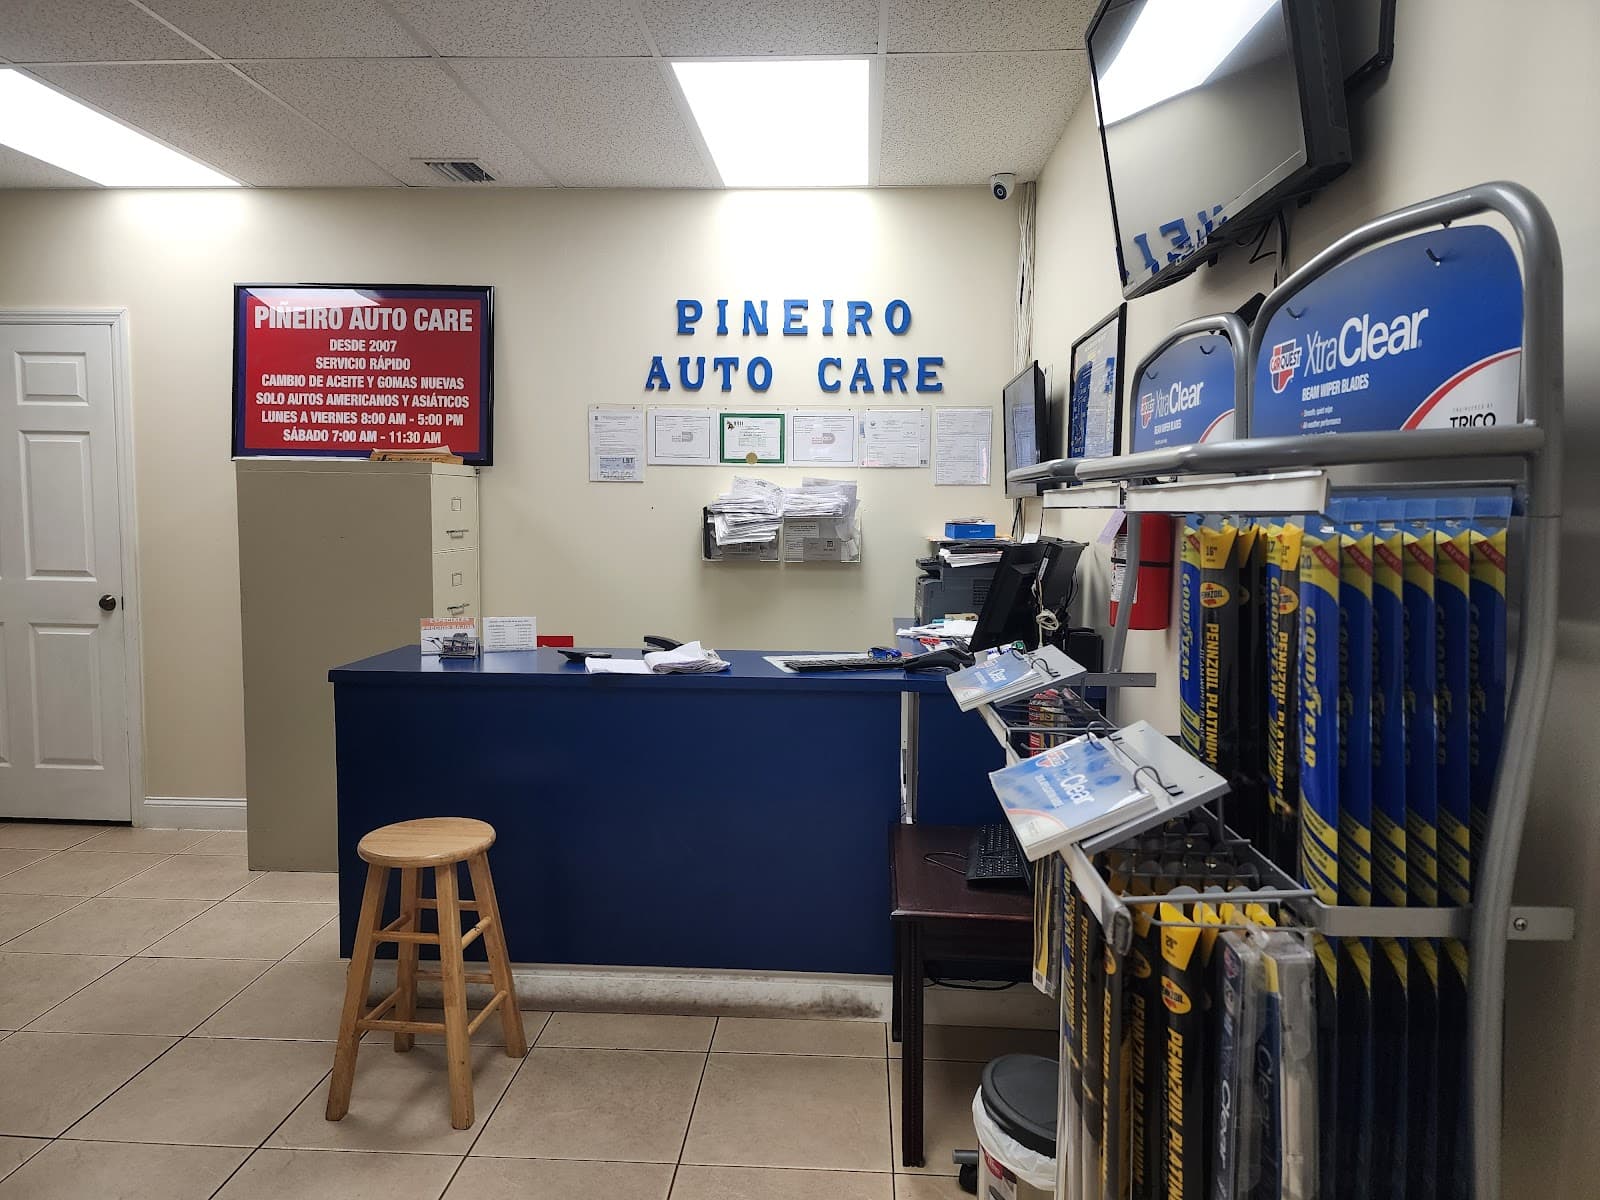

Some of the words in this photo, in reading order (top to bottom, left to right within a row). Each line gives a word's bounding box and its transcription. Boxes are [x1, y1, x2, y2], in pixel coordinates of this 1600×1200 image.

[349, 308, 407, 331] AUTO
[413, 308, 473, 332] CARE
[676, 299, 913, 336] PINEIRO
[329, 339, 366, 351] DESDE
[369, 340, 397, 352] 2007
[315, 357, 366, 370] SERVICIO
[369, 355, 411, 371] RÁPIDO
[645, 355, 773, 393] AUTO
[817, 355, 945, 393] CARE
[261, 374, 305, 387] CAMBIO
[308, 374, 324, 387] DE
[326, 375, 364, 388] ACEITE
[366, 376, 374, 388] Y
[377, 376, 417, 389] GOMAS
[420, 377, 465, 390] NUEVAS
[1302, 386, 1320, 401] BEAM
[1320, 380, 1341, 398] WIPER
[1341, 373, 1369, 395] BLADES
[255, 392, 285, 405] SOLO
[287, 393, 324, 406] AUTOS
[325, 393, 399, 407] AMERICANOS
[401, 394, 410, 407] Y
[411, 392, 470, 408] ASIÁTICOS
[261, 410, 298, 423] LUNES
[300, 411, 308, 423] A
[310, 411, 358, 424] VIERNES
[360, 412, 386, 425] 8:00
[387, 413, 406, 425] AM
[417, 413, 443, 426] 5:00
[446, 414, 464, 426] PM
[283, 426, 329, 442] SÁBADO
[331, 429, 356, 442] 7:00
[359, 430, 377, 443] AM
[388, 431, 420, 443] 11:30
[422, 431, 441, 444] AM
[1181, 573, 1194, 681] GOODYEAR
[1206, 622, 1220, 690] PENNZOIL
[1303, 605, 1322, 769] GOODYEAR
[1206, 692, 1219, 764] PLATINUM
[1167, 1026, 1183, 1126] PENNZOIL
